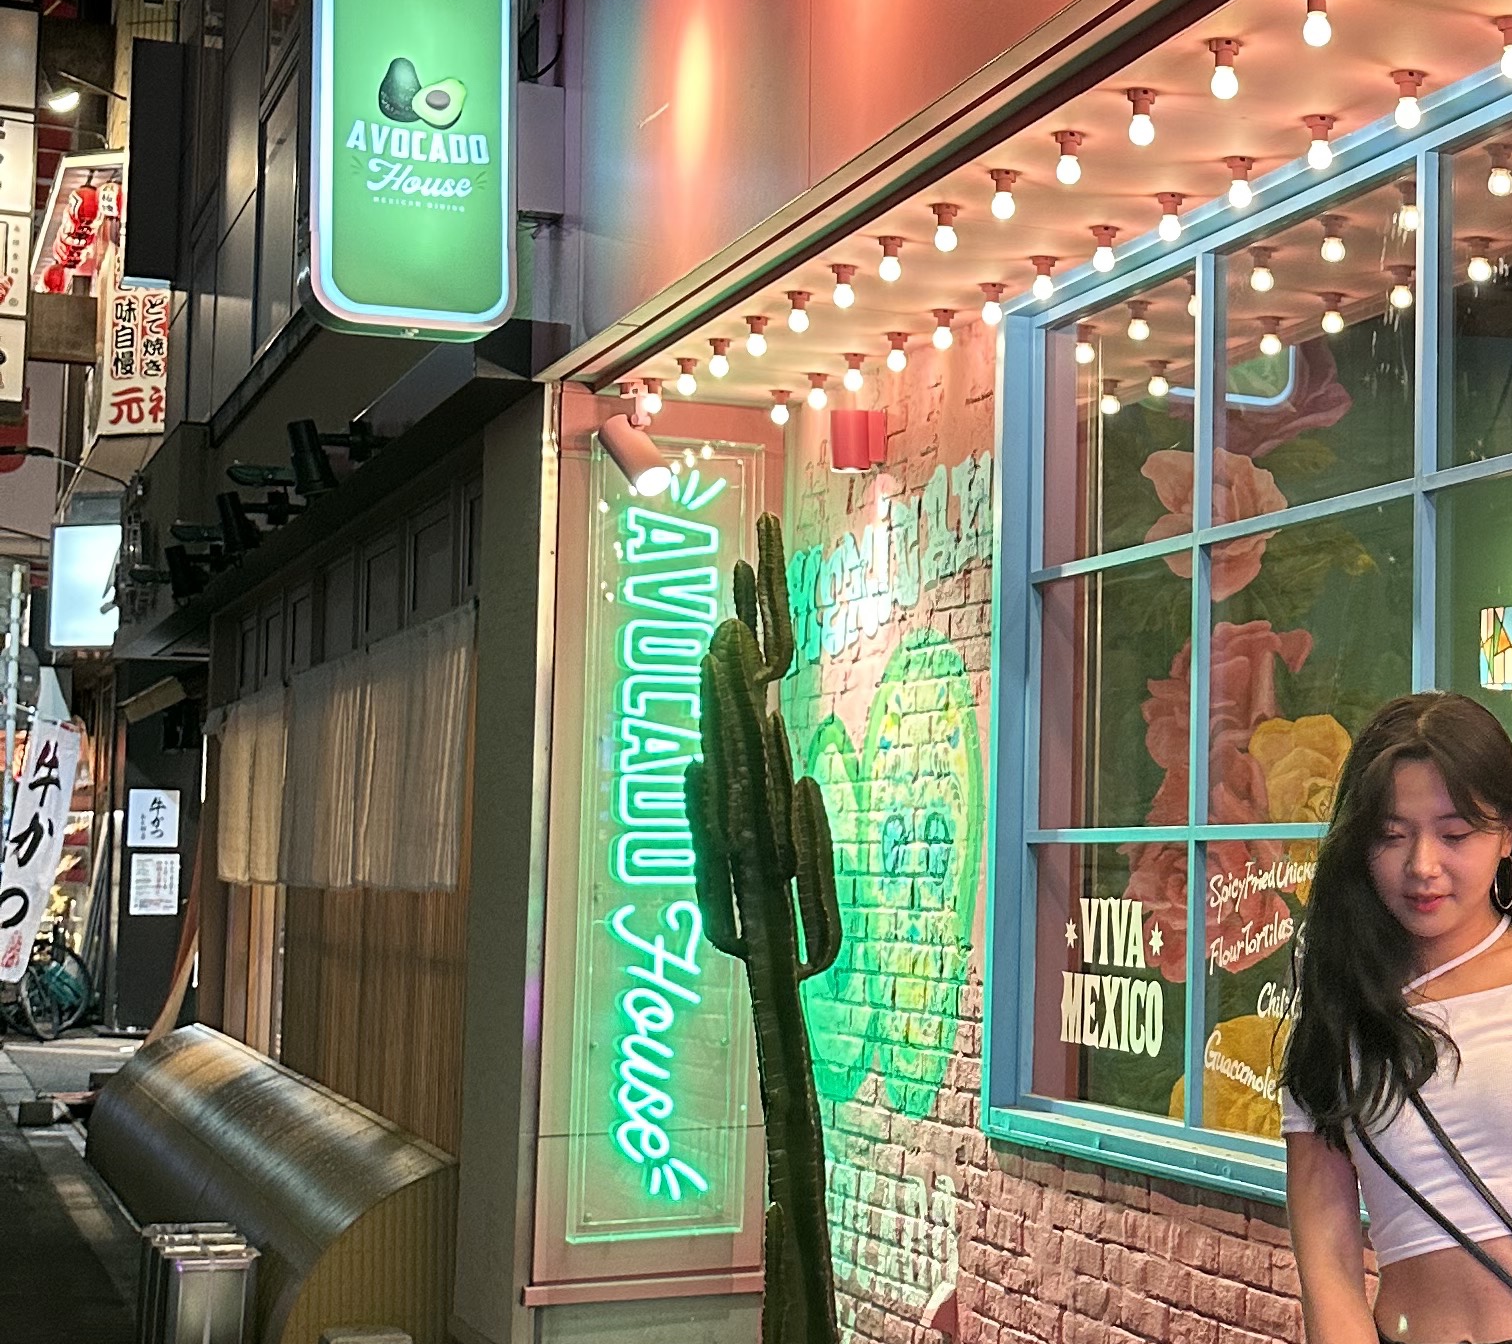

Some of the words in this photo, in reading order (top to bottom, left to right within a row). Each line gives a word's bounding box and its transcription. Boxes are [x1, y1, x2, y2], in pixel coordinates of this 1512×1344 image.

[346, 119, 490, 165] AVOCADO
[366, 157, 473, 198] House
[616, 506, 719, 885] AVOCADO
[0, 740, 62, 929] 牛かつ
[149, 797, 166, 838] 牛かつ
[1209, 872, 1246, 925] Spicy
[1243, 861, 1275, 899] Fried
[1080, 897, 1146, 969] VIVA
[1209, 936, 1245, 976] Flour
[611, 900, 703, 1163] House
[1060, 971, 1164, 1058] MEXICO
